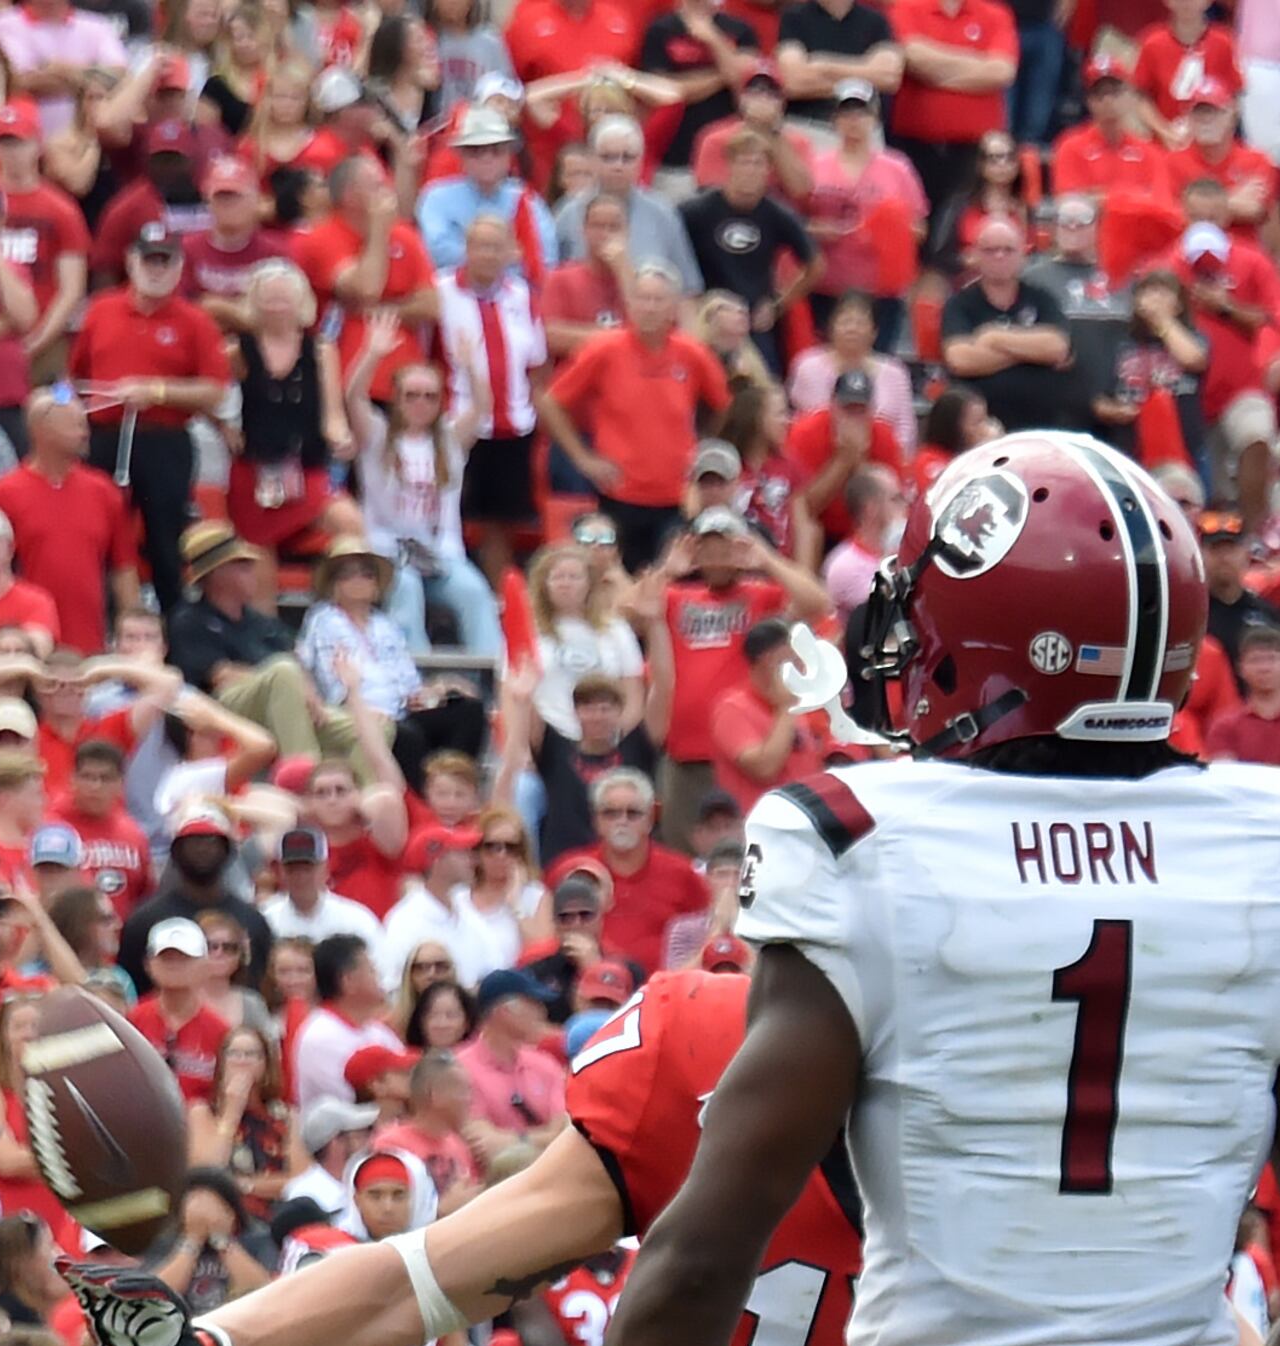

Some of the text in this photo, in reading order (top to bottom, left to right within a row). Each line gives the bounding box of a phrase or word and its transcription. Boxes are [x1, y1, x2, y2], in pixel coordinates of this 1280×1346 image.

[1029, 632, 1073, 675] SEC
[1011, 821, 1158, 884] HORN
[1051, 918, 1134, 1194] 1
